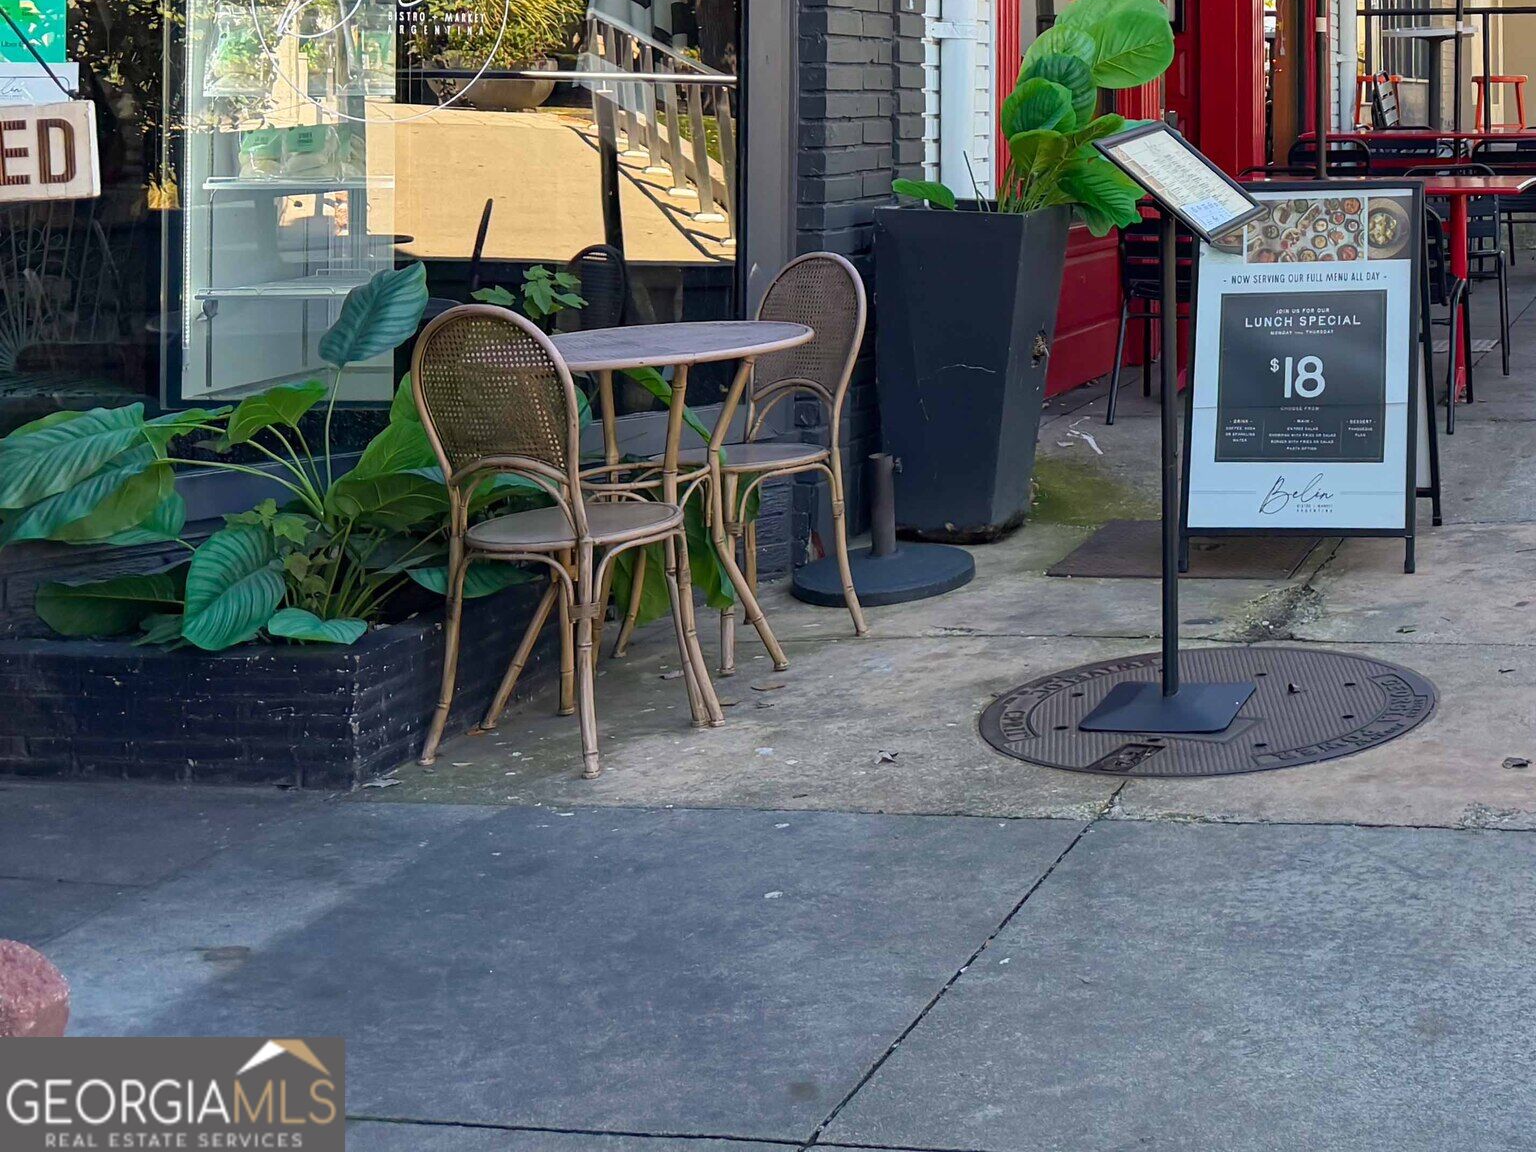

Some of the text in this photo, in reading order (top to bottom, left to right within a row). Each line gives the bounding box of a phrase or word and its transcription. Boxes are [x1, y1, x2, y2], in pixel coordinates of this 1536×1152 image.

[387, 11, 426, 23] BISTRO
[444, 12, 486, 23] MARKET
[387, 25, 485, 36] ARGENTINA
[1231, 272, 1380, 284] NOW SERVING OUR FULL MENU ALL DAY
[1245, 315, 1361, 328] LUNCH SPECIAL
[1270, 355, 1326, 399] $18
